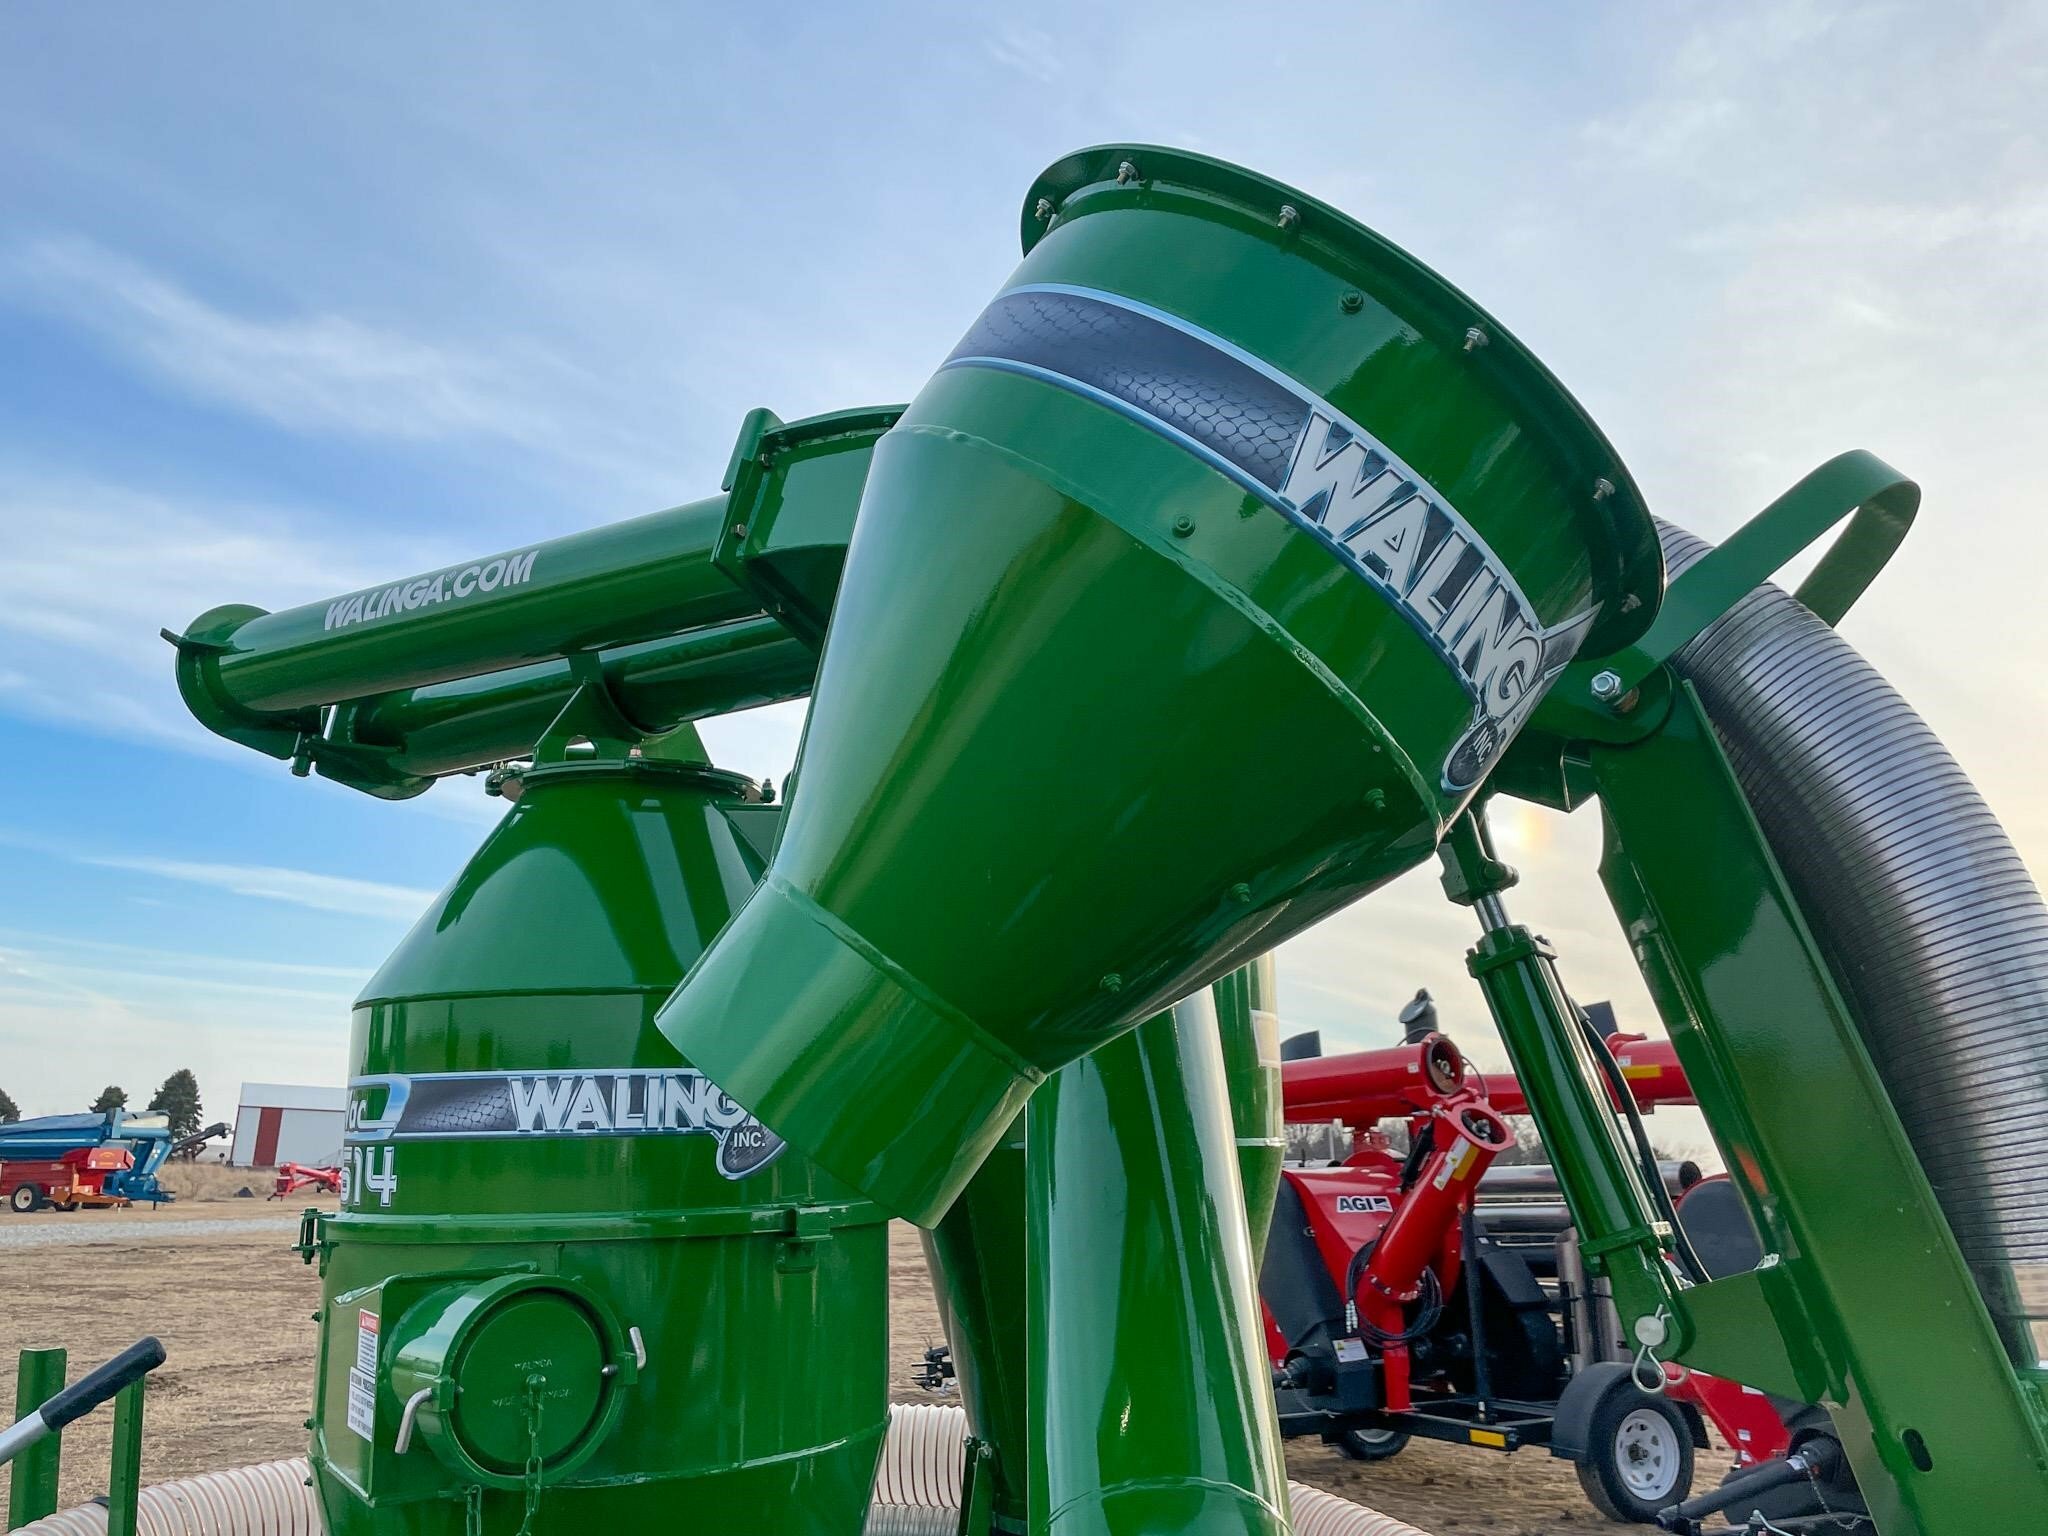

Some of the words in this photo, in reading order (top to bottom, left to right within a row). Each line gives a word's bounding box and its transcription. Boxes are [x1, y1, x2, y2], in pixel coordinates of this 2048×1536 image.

[1277, 406, 1552, 742] WALING
[508, 1074, 762, 1132] WALING
[733, 1131, 766, 1149] INC.
[1338, 1197, 1374, 1211] AGI
